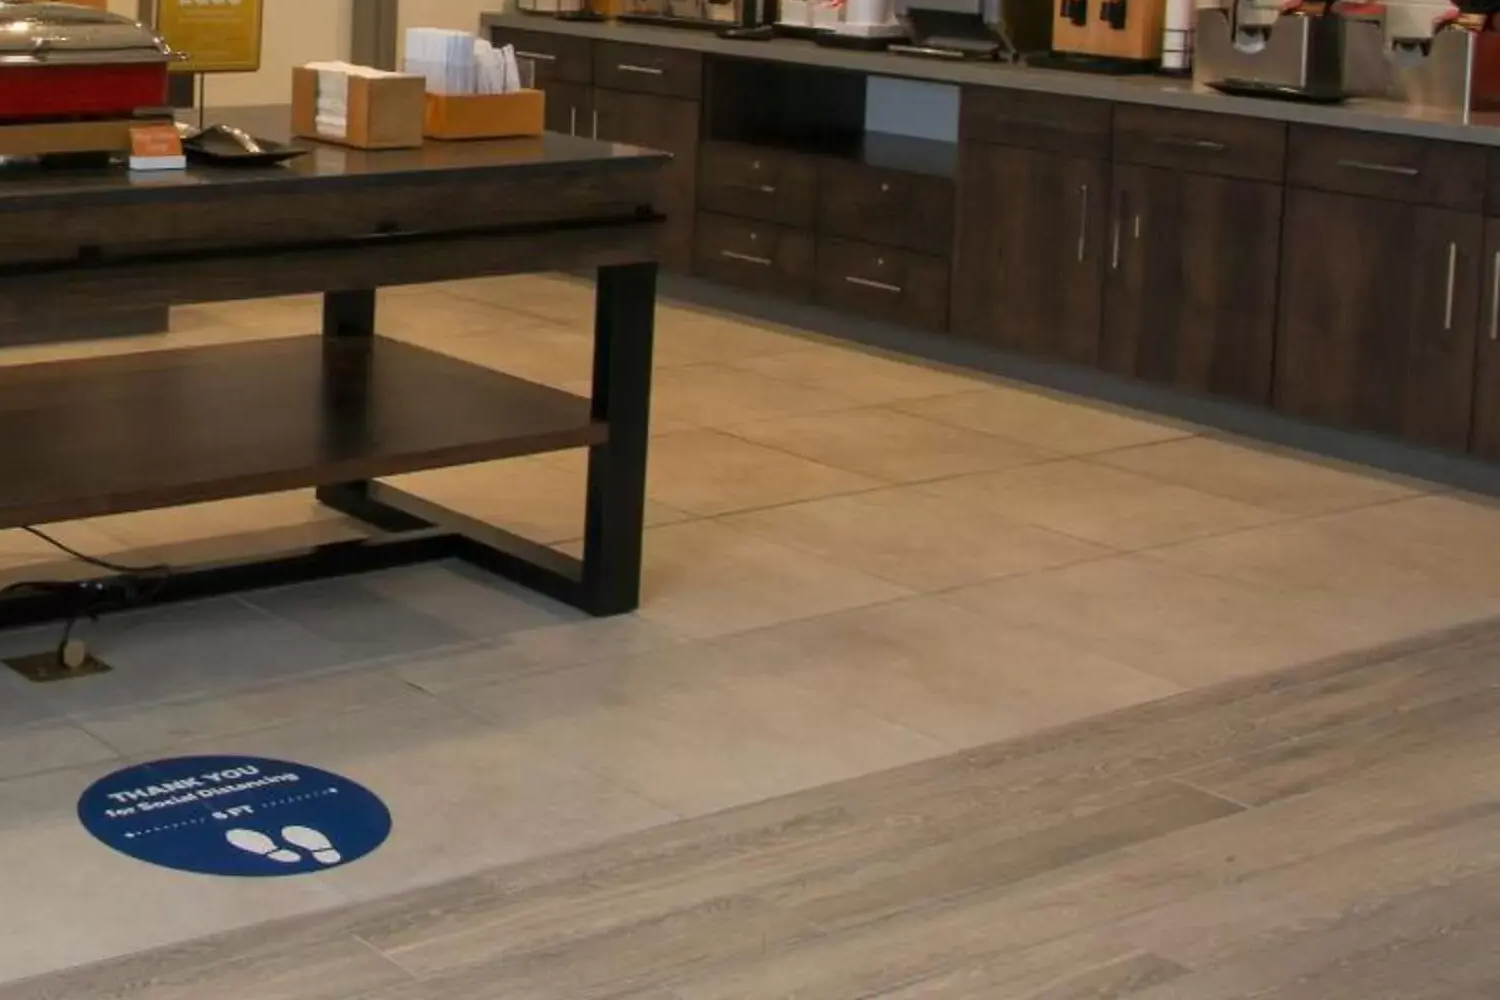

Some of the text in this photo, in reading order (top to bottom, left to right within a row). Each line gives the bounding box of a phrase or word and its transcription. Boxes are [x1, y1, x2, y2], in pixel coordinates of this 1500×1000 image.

[106, 764, 260, 803] THANK YOU
[137, 792, 199, 812] Social
[196, 772, 300, 799] Distancing
